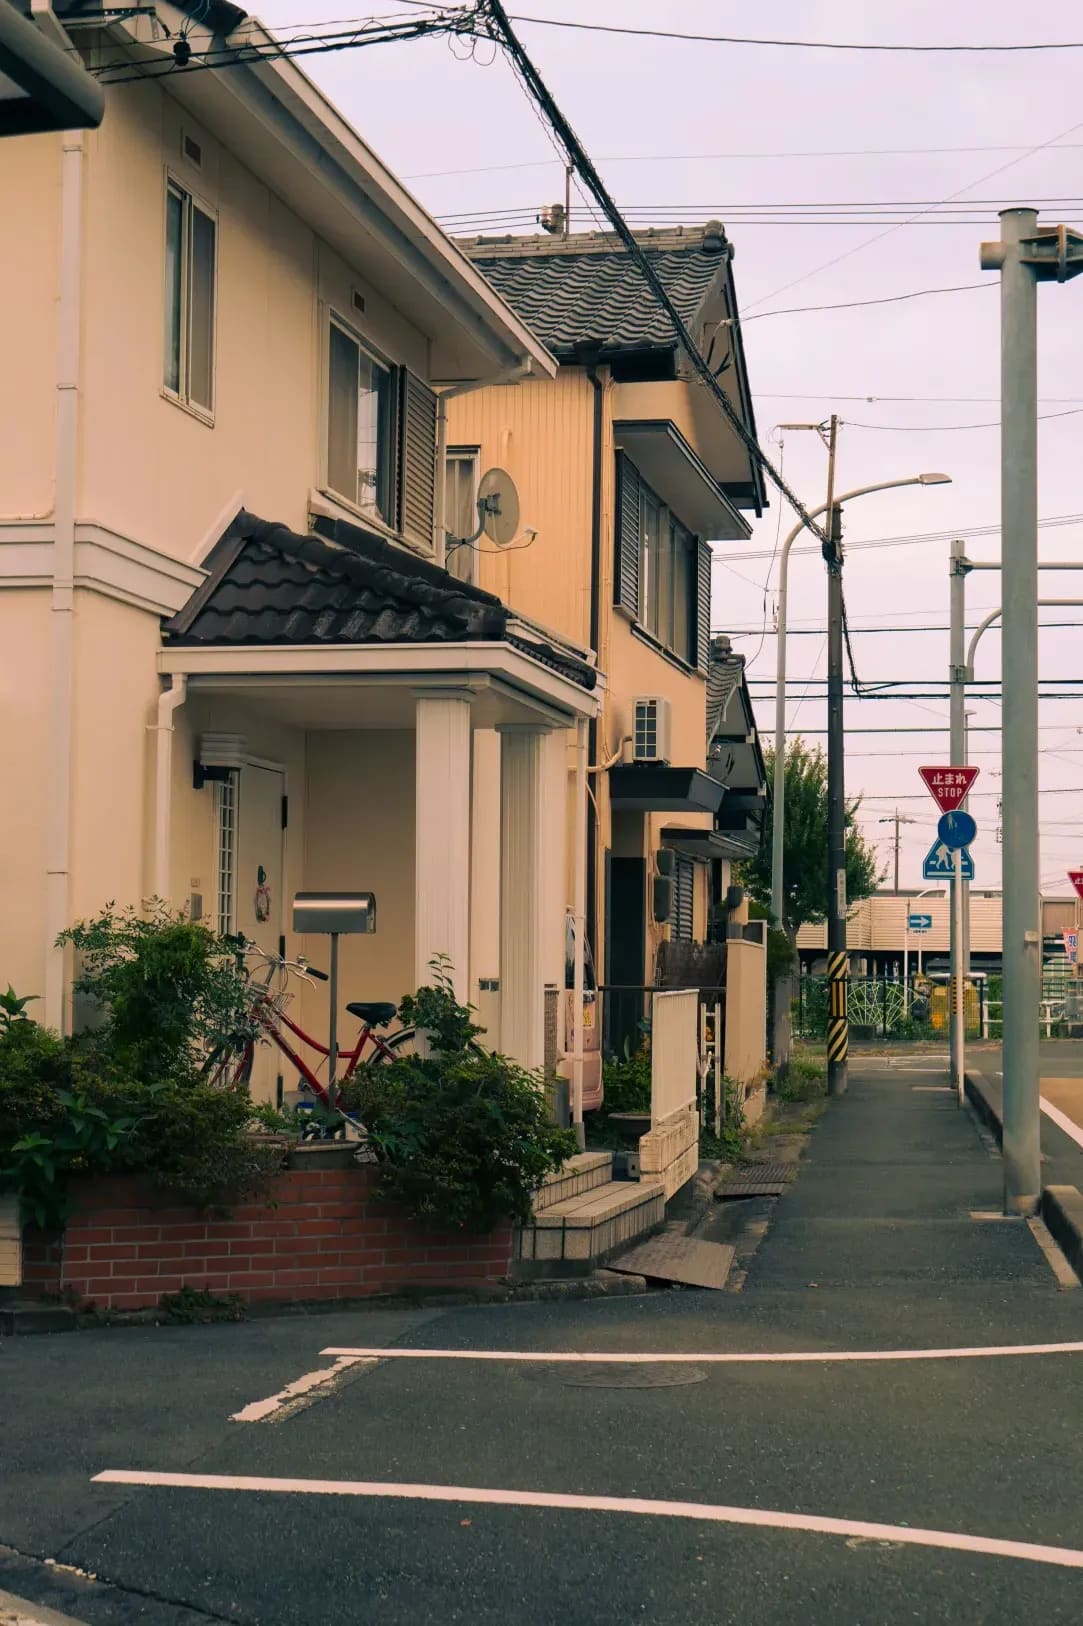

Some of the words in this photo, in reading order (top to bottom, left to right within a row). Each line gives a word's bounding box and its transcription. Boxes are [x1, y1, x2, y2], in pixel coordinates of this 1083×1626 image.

[932, 772, 967, 785] 止まれ
[938, 787, 962, 798] STOP
